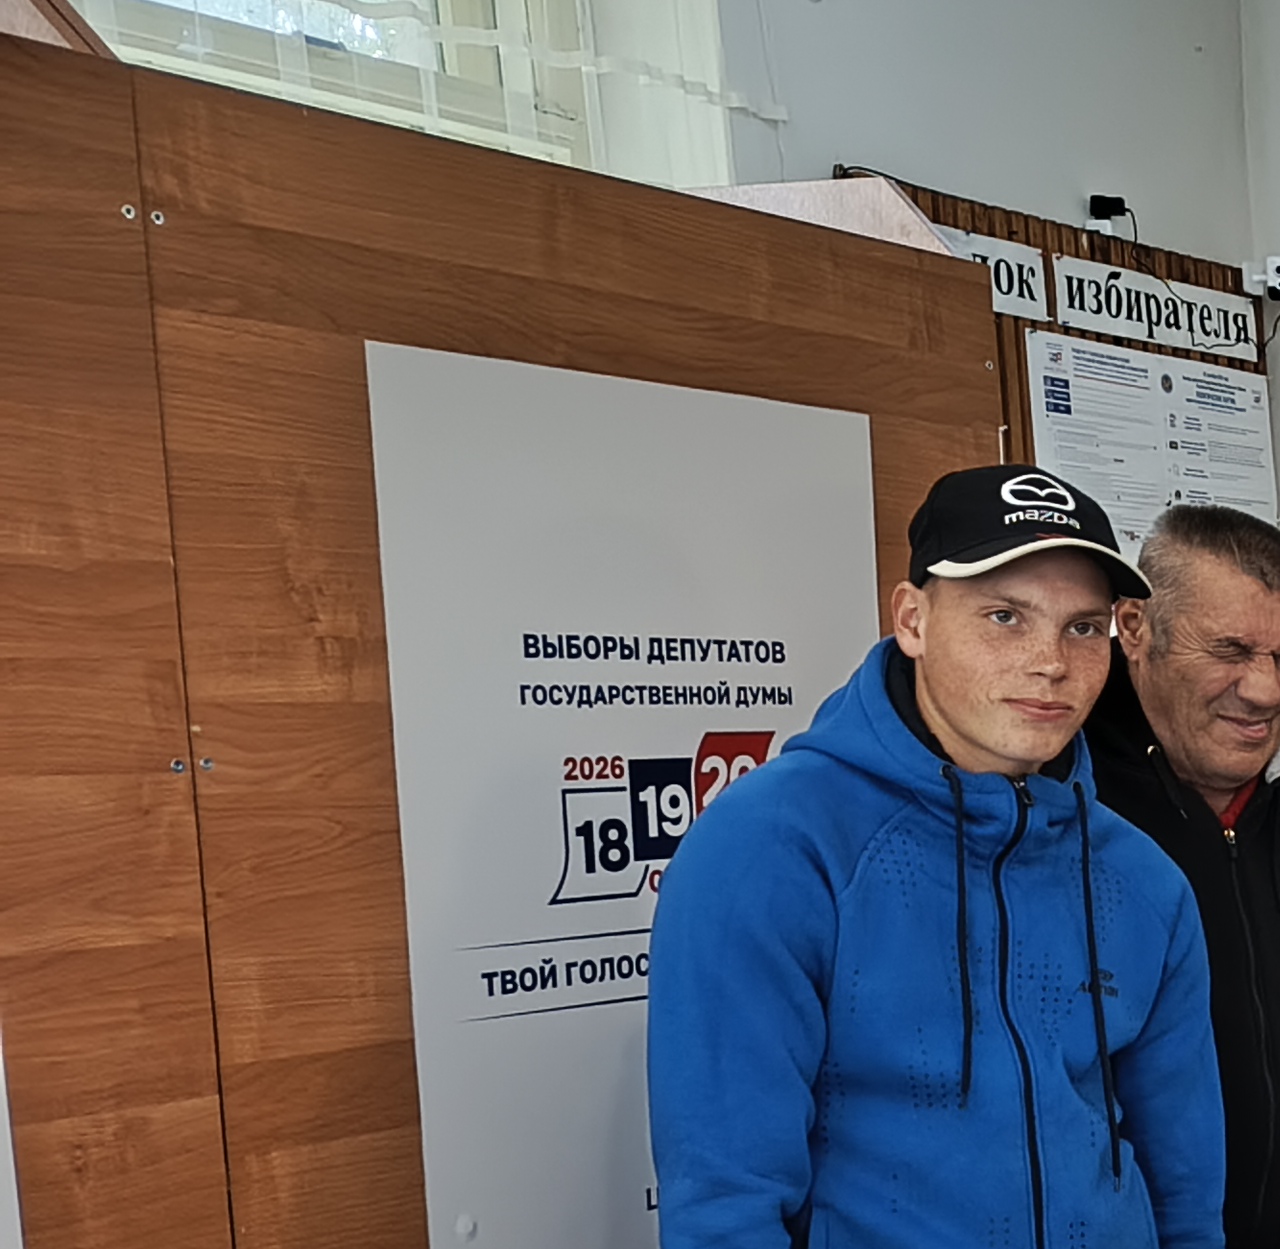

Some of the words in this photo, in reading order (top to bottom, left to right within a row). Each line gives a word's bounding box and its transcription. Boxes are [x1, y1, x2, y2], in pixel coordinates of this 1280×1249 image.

[1064, 271, 1250, 345] избирателя
[522, 633, 640, 661] ВЫБОРЫ
[647, 636, 786, 665] ДЕПУТАТОВ
[519, 681, 730, 709] ГОСУДАРСТВЕННОЙ
[735, 685, 793, 709] ДУМЫ
[563, 756, 625, 781] 2026
[575, 818, 631, 874] 18
[638, 783, 692, 838] 19
[481, 957, 558, 997] ТВОЙ
[565, 953, 650, 988] ГОЛОС
